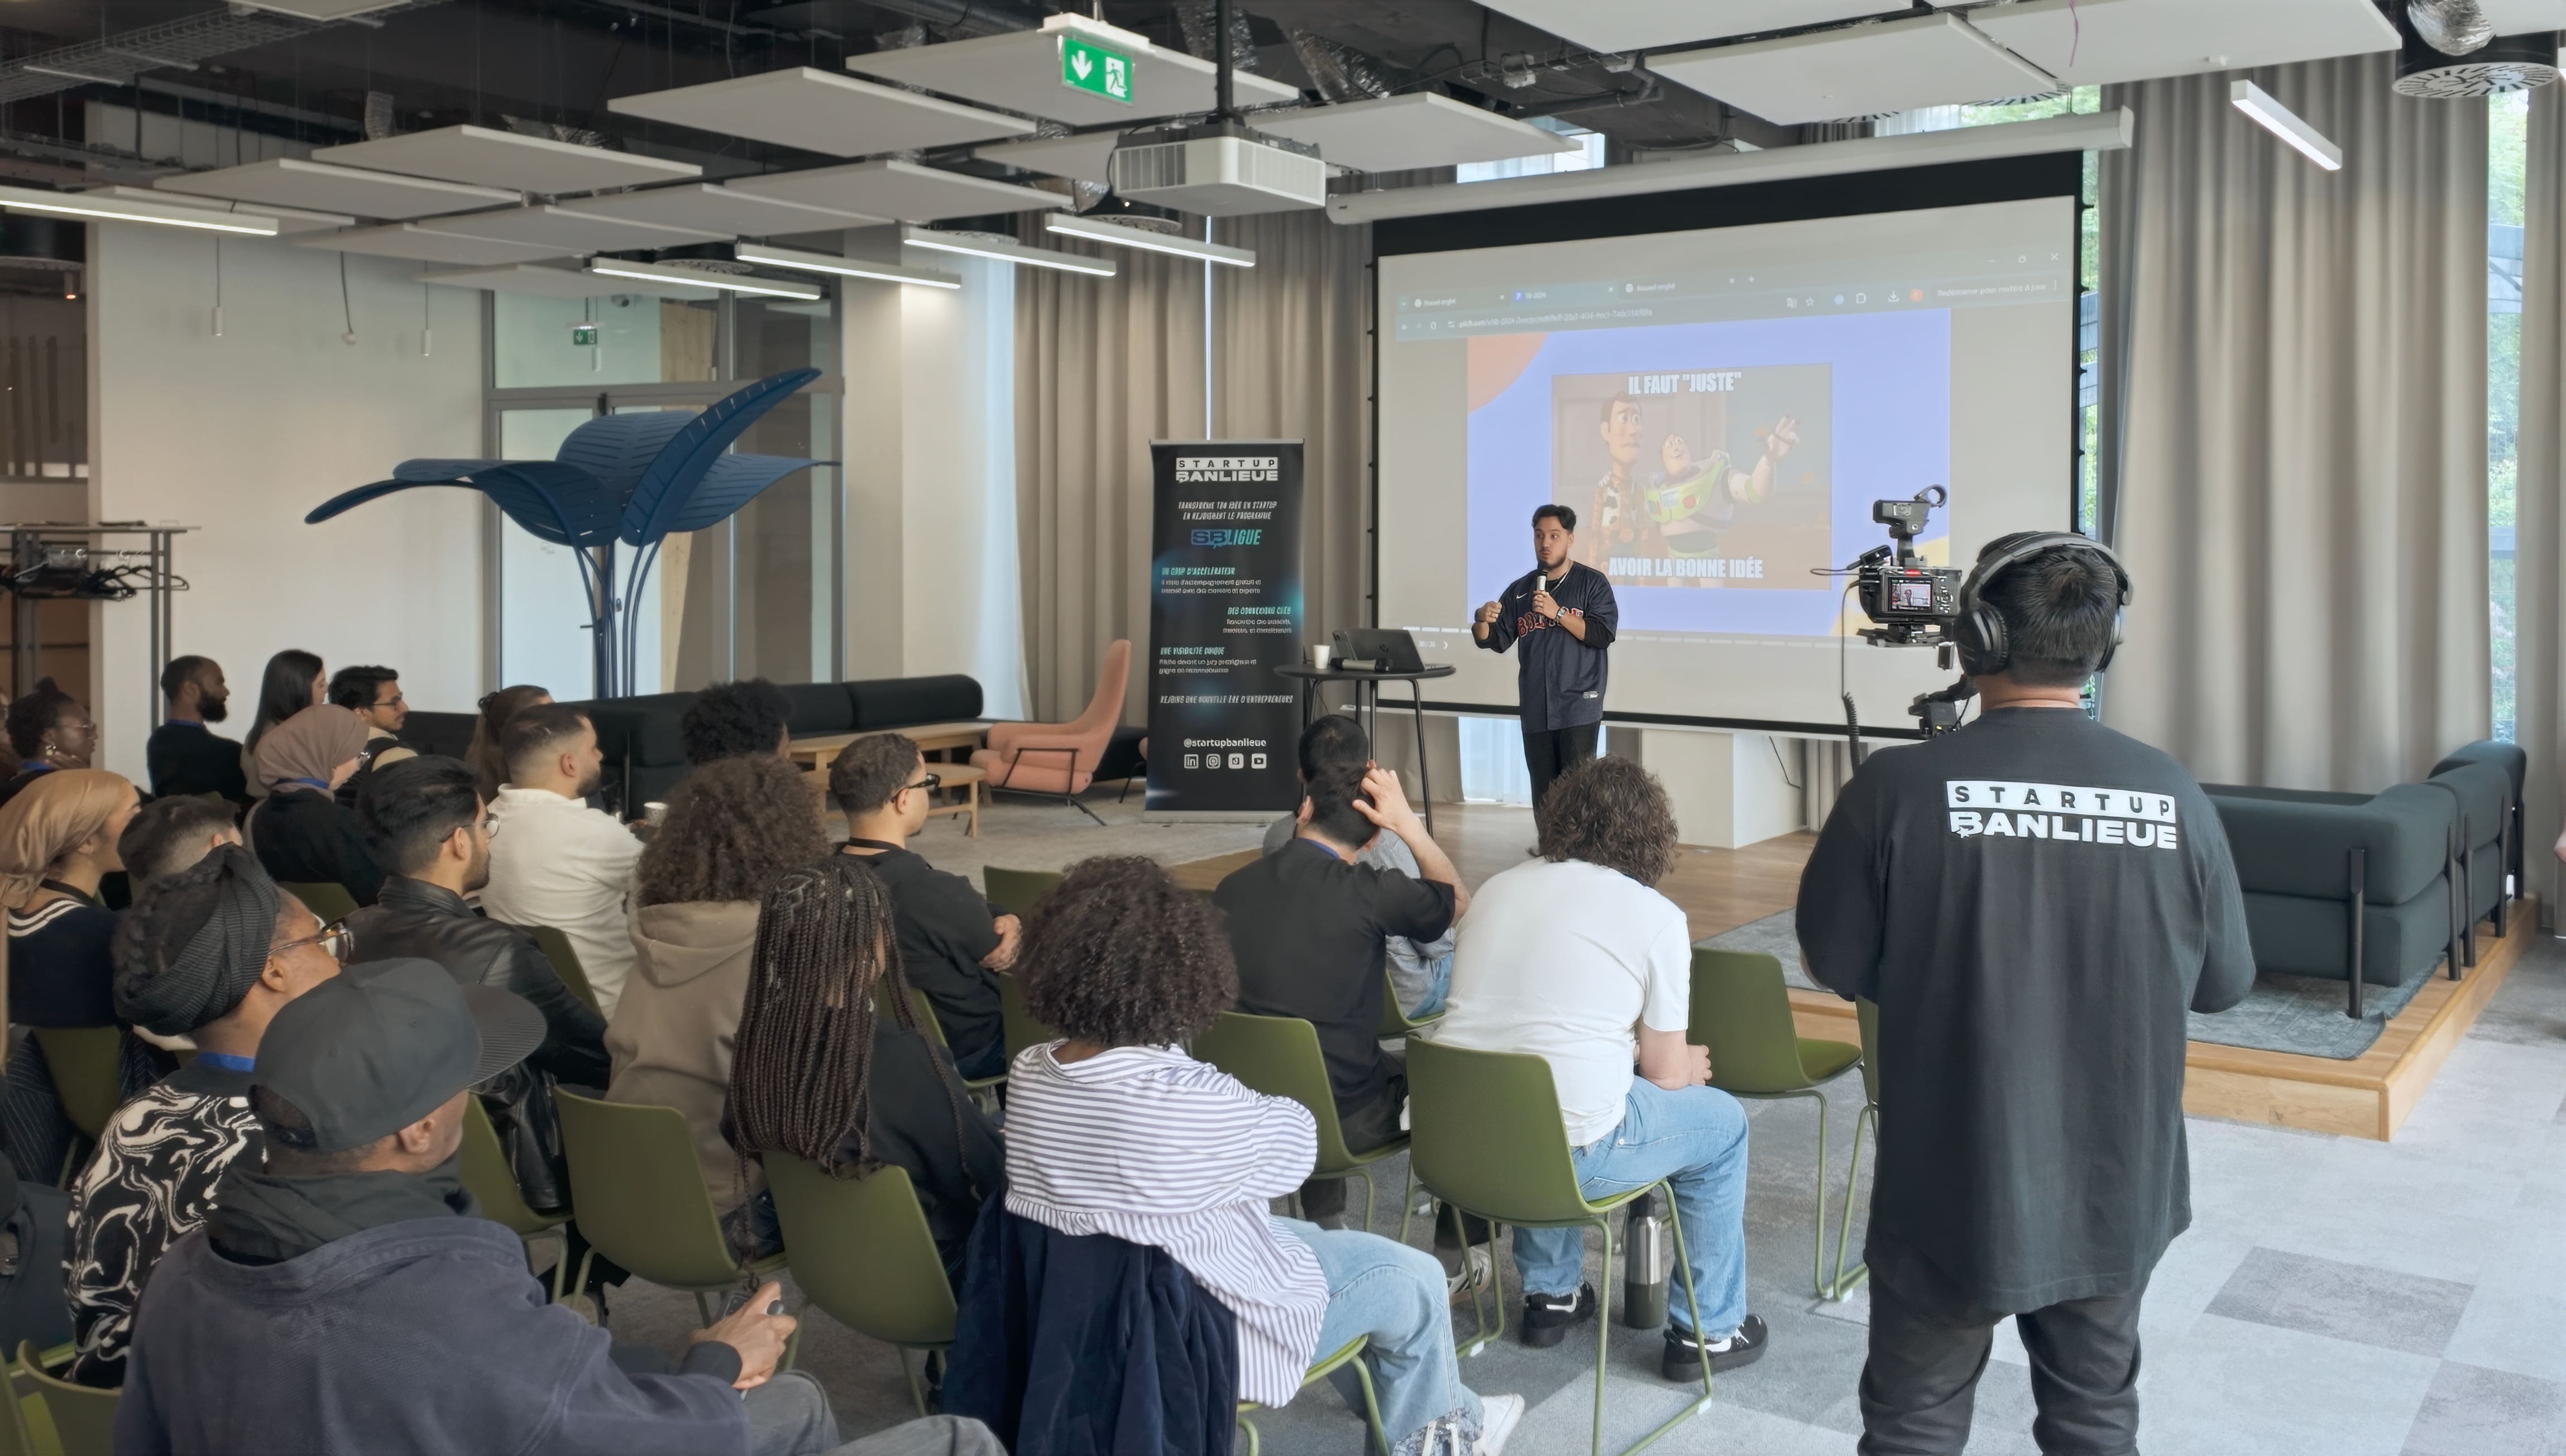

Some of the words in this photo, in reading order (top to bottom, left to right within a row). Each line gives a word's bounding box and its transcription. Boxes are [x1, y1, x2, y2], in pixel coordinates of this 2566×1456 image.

[1628, 376, 1641, 395] IL
[1644, 375, 1679, 394] FAUT
[1683, 371, 1742, 392] "JUSTE"
[1178, 459, 1276, 468] STARTUP
[1176, 470, 1278, 483] BANLIEUE
[1608, 557, 1651, 577] AVOIR
[1655, 558, 1673, 577] LA
[1676, 559, 1726, 578] BONNE
[1730, 556, 1763, 578] IDÉE
[1955, 785, 2170, 817] STARTUP
[1950, 811, 2177, 850] BANLIEUE
